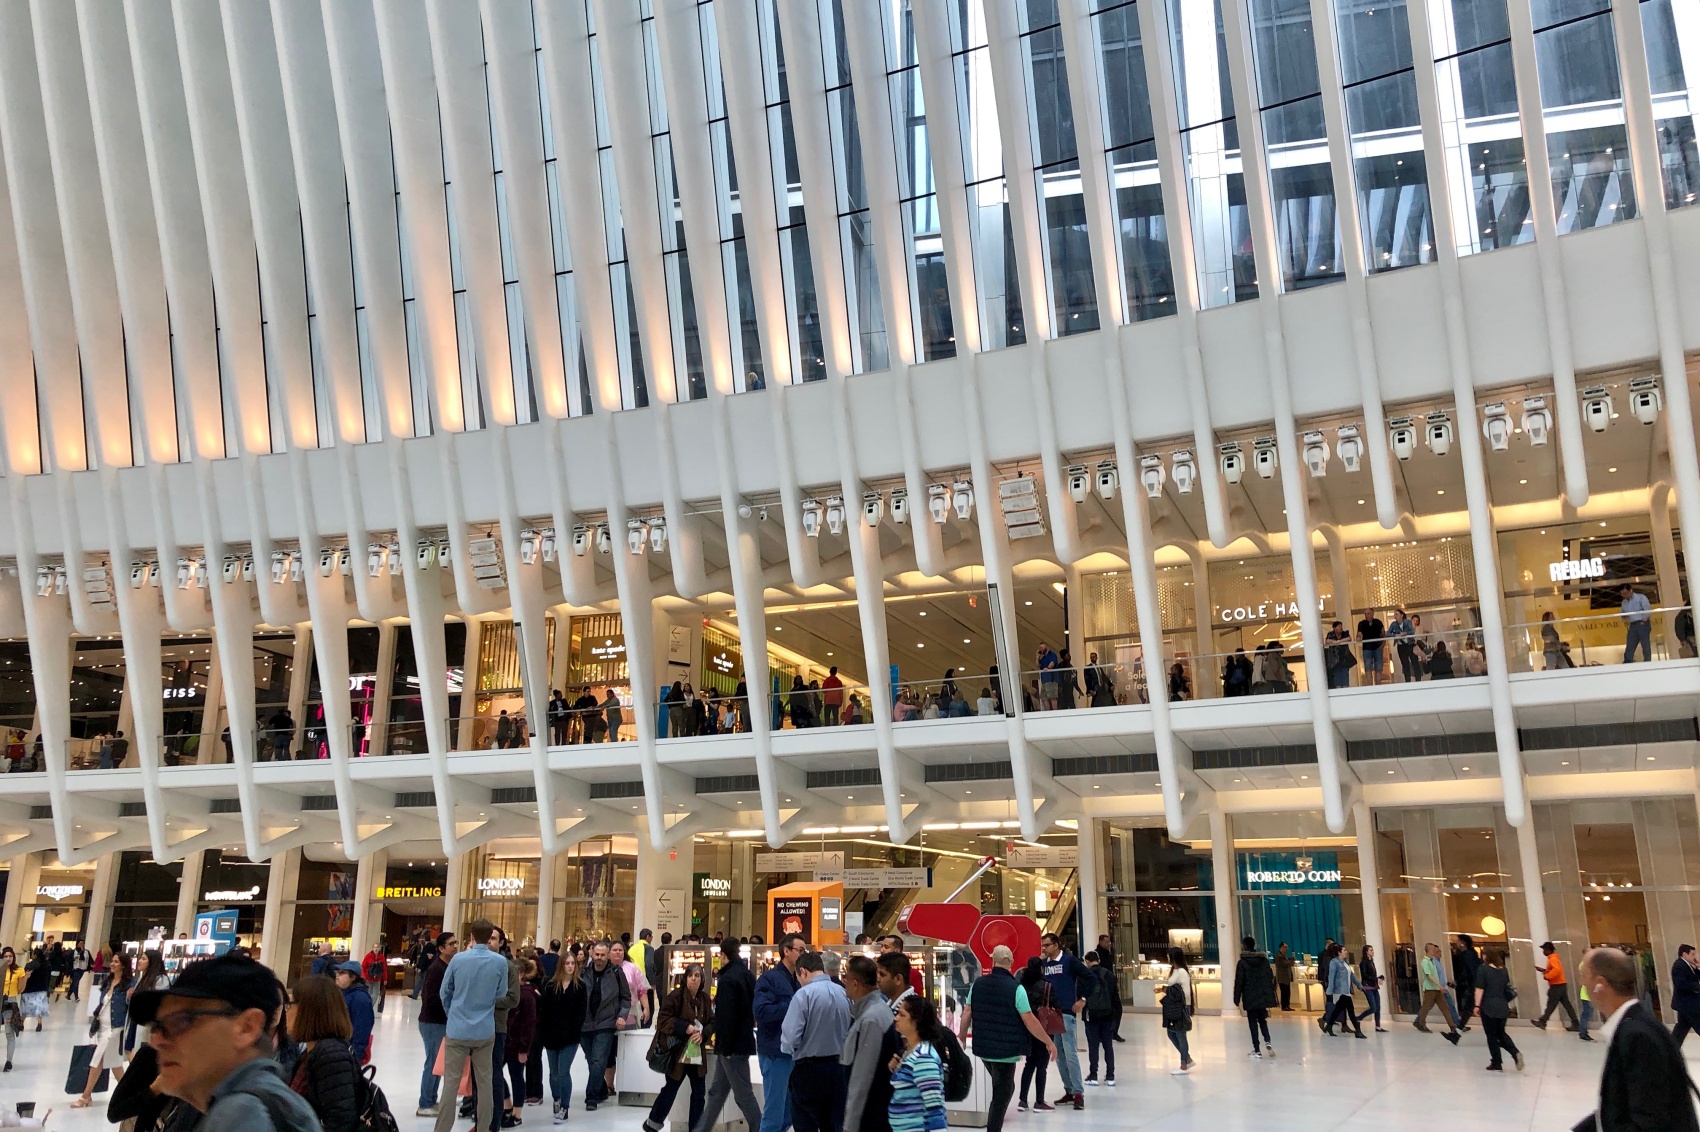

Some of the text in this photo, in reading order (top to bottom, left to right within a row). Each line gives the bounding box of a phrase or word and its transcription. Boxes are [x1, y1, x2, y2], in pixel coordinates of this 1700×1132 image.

[1221, 598, 1324, 621] COLE HAN
[163, 687, 196, 698] EISS
[1247, 870, 1341, 883] ROBERTO COIN
[478, 878, 525, 890] LONDON
[701, 878, 731, 890] LONDON
[376, 887, 442, 898] BREITLING
